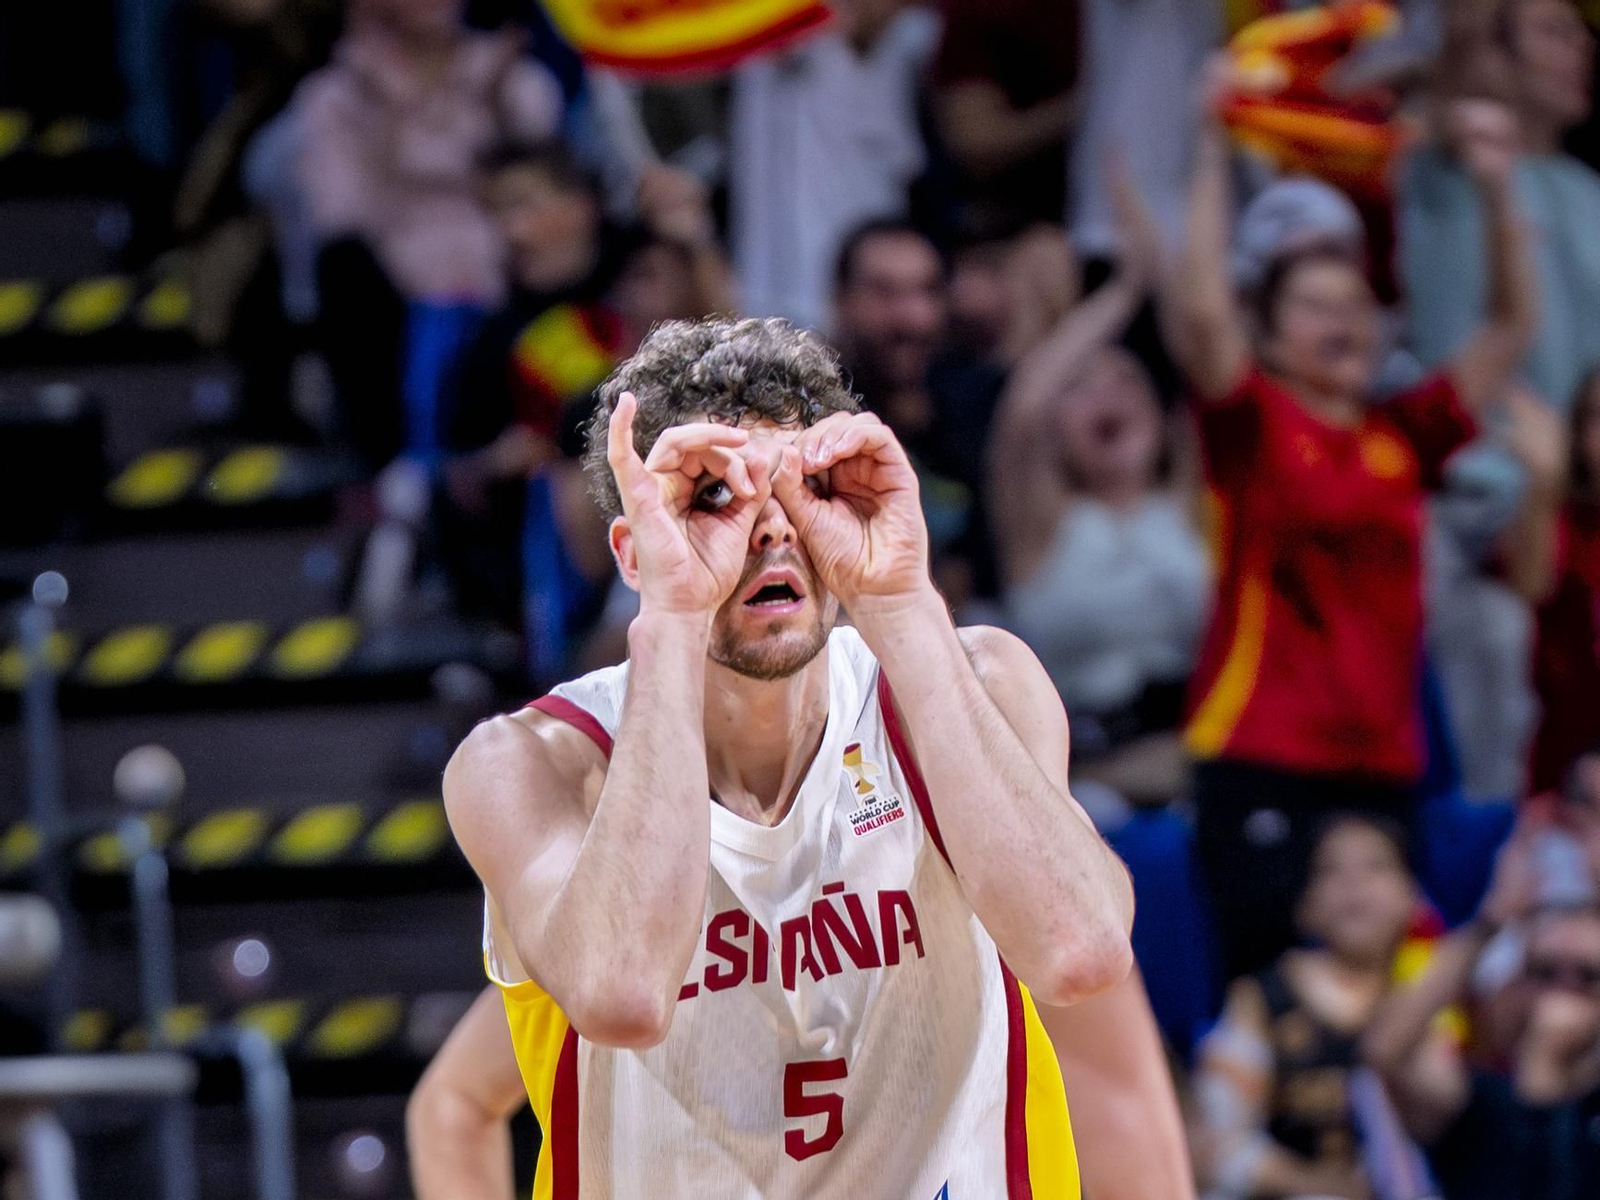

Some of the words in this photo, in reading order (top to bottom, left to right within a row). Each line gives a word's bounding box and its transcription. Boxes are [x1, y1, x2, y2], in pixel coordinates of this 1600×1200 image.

[850, 807, 881, 826] WORLD
[883, 800, 900, 812] CUP
[854, 808, 905, 836] QUALIFIERS
[677, 881, 925, 1001] SAÑA
[784, 1057, 848, 1161] 5
